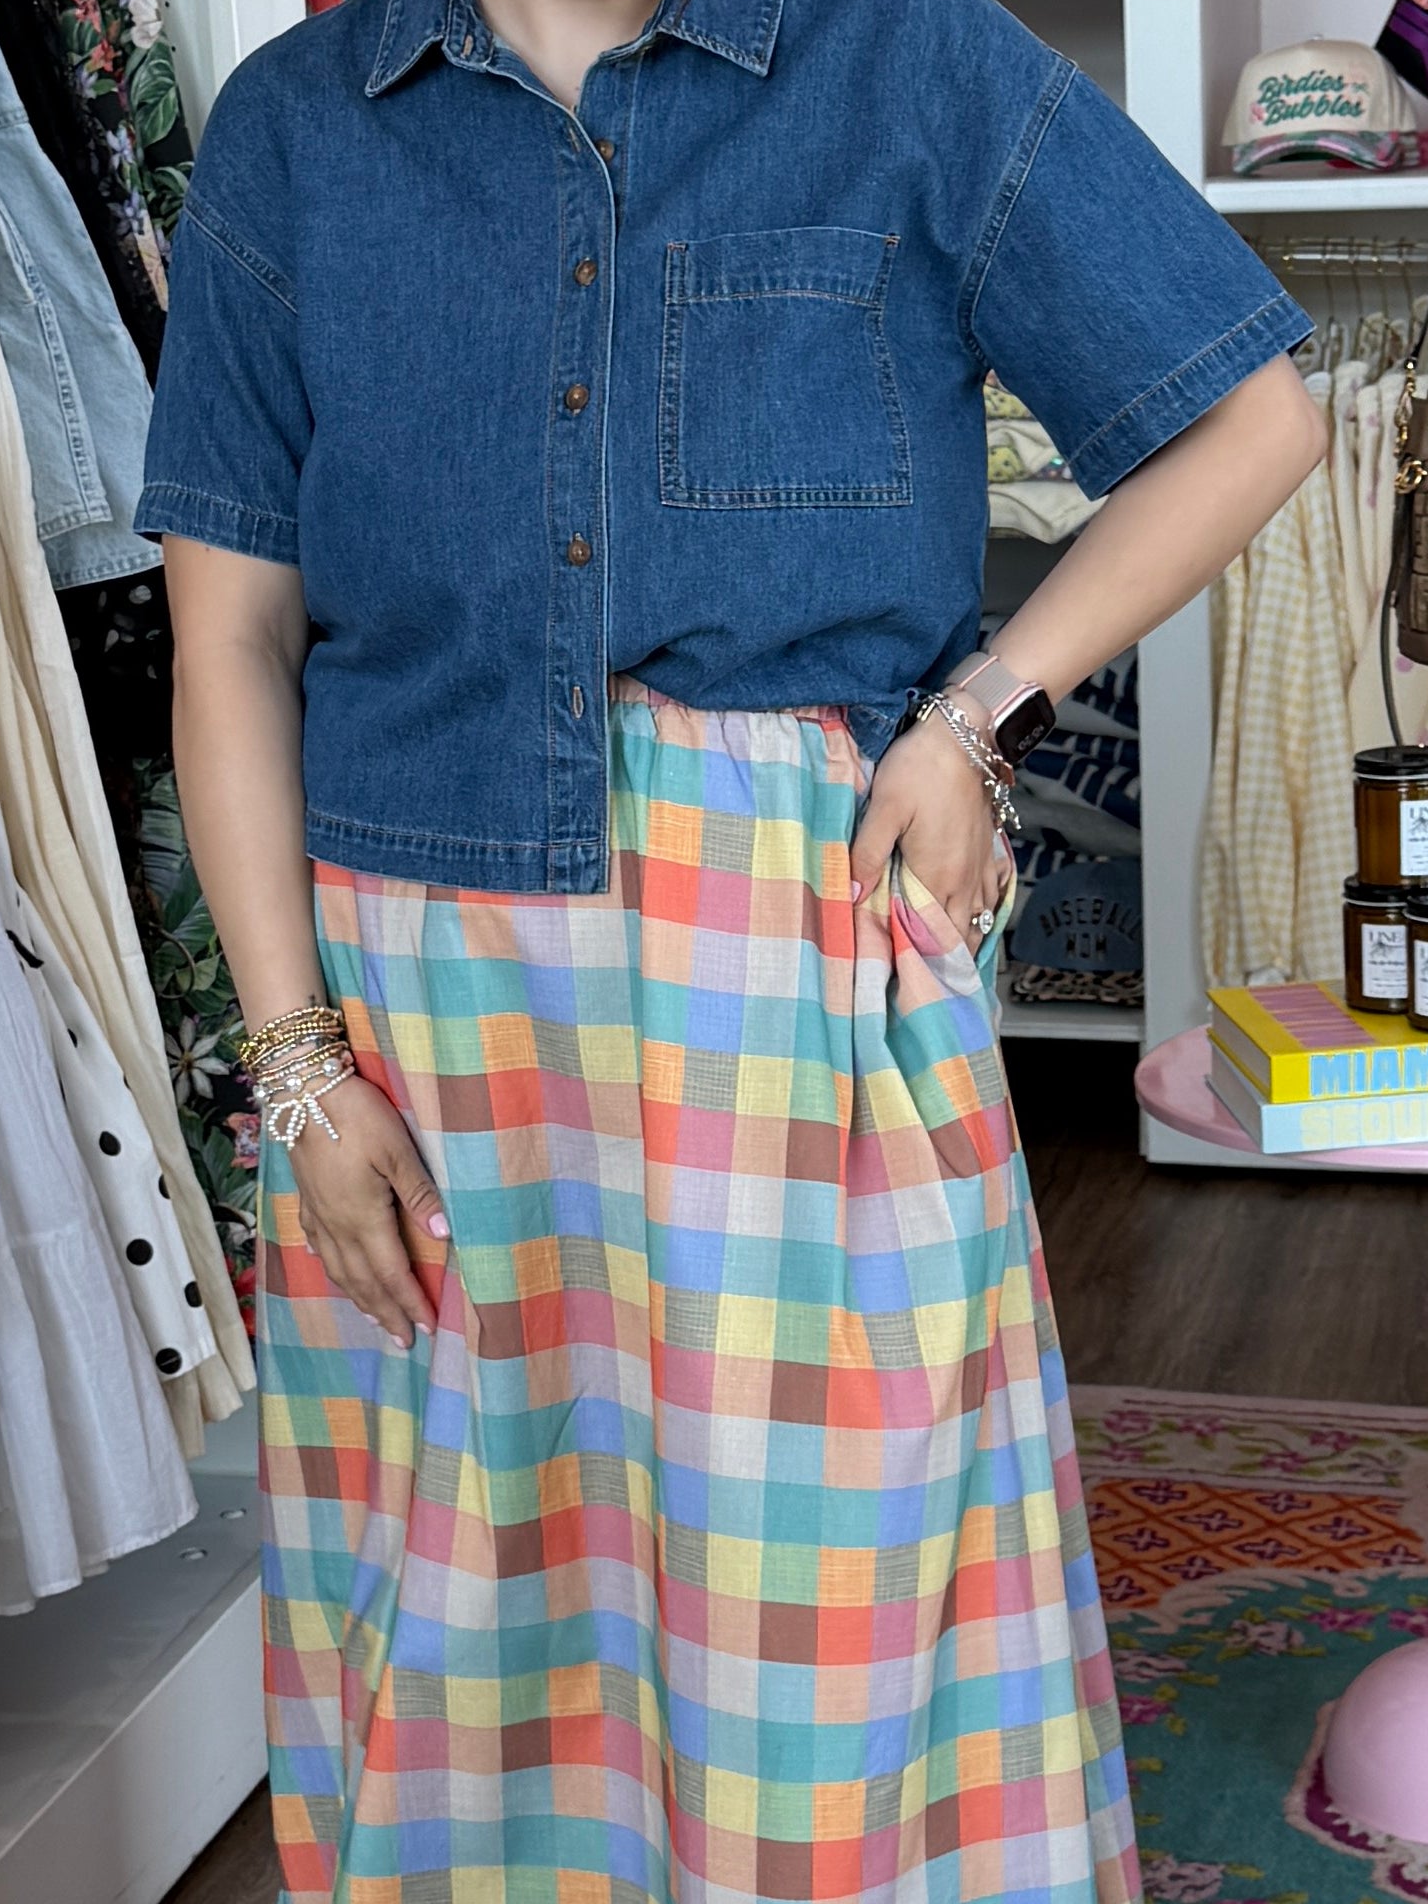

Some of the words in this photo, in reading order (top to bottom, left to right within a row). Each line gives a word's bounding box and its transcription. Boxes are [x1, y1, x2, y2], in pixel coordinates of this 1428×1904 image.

[1257, 69, 1344, 104] Birdies
[1263, 94, 1365, 126] Bubbles
[1038, 897, 1142, 940] BASEBALL
[1065, 932, 1108, 960] MOM
